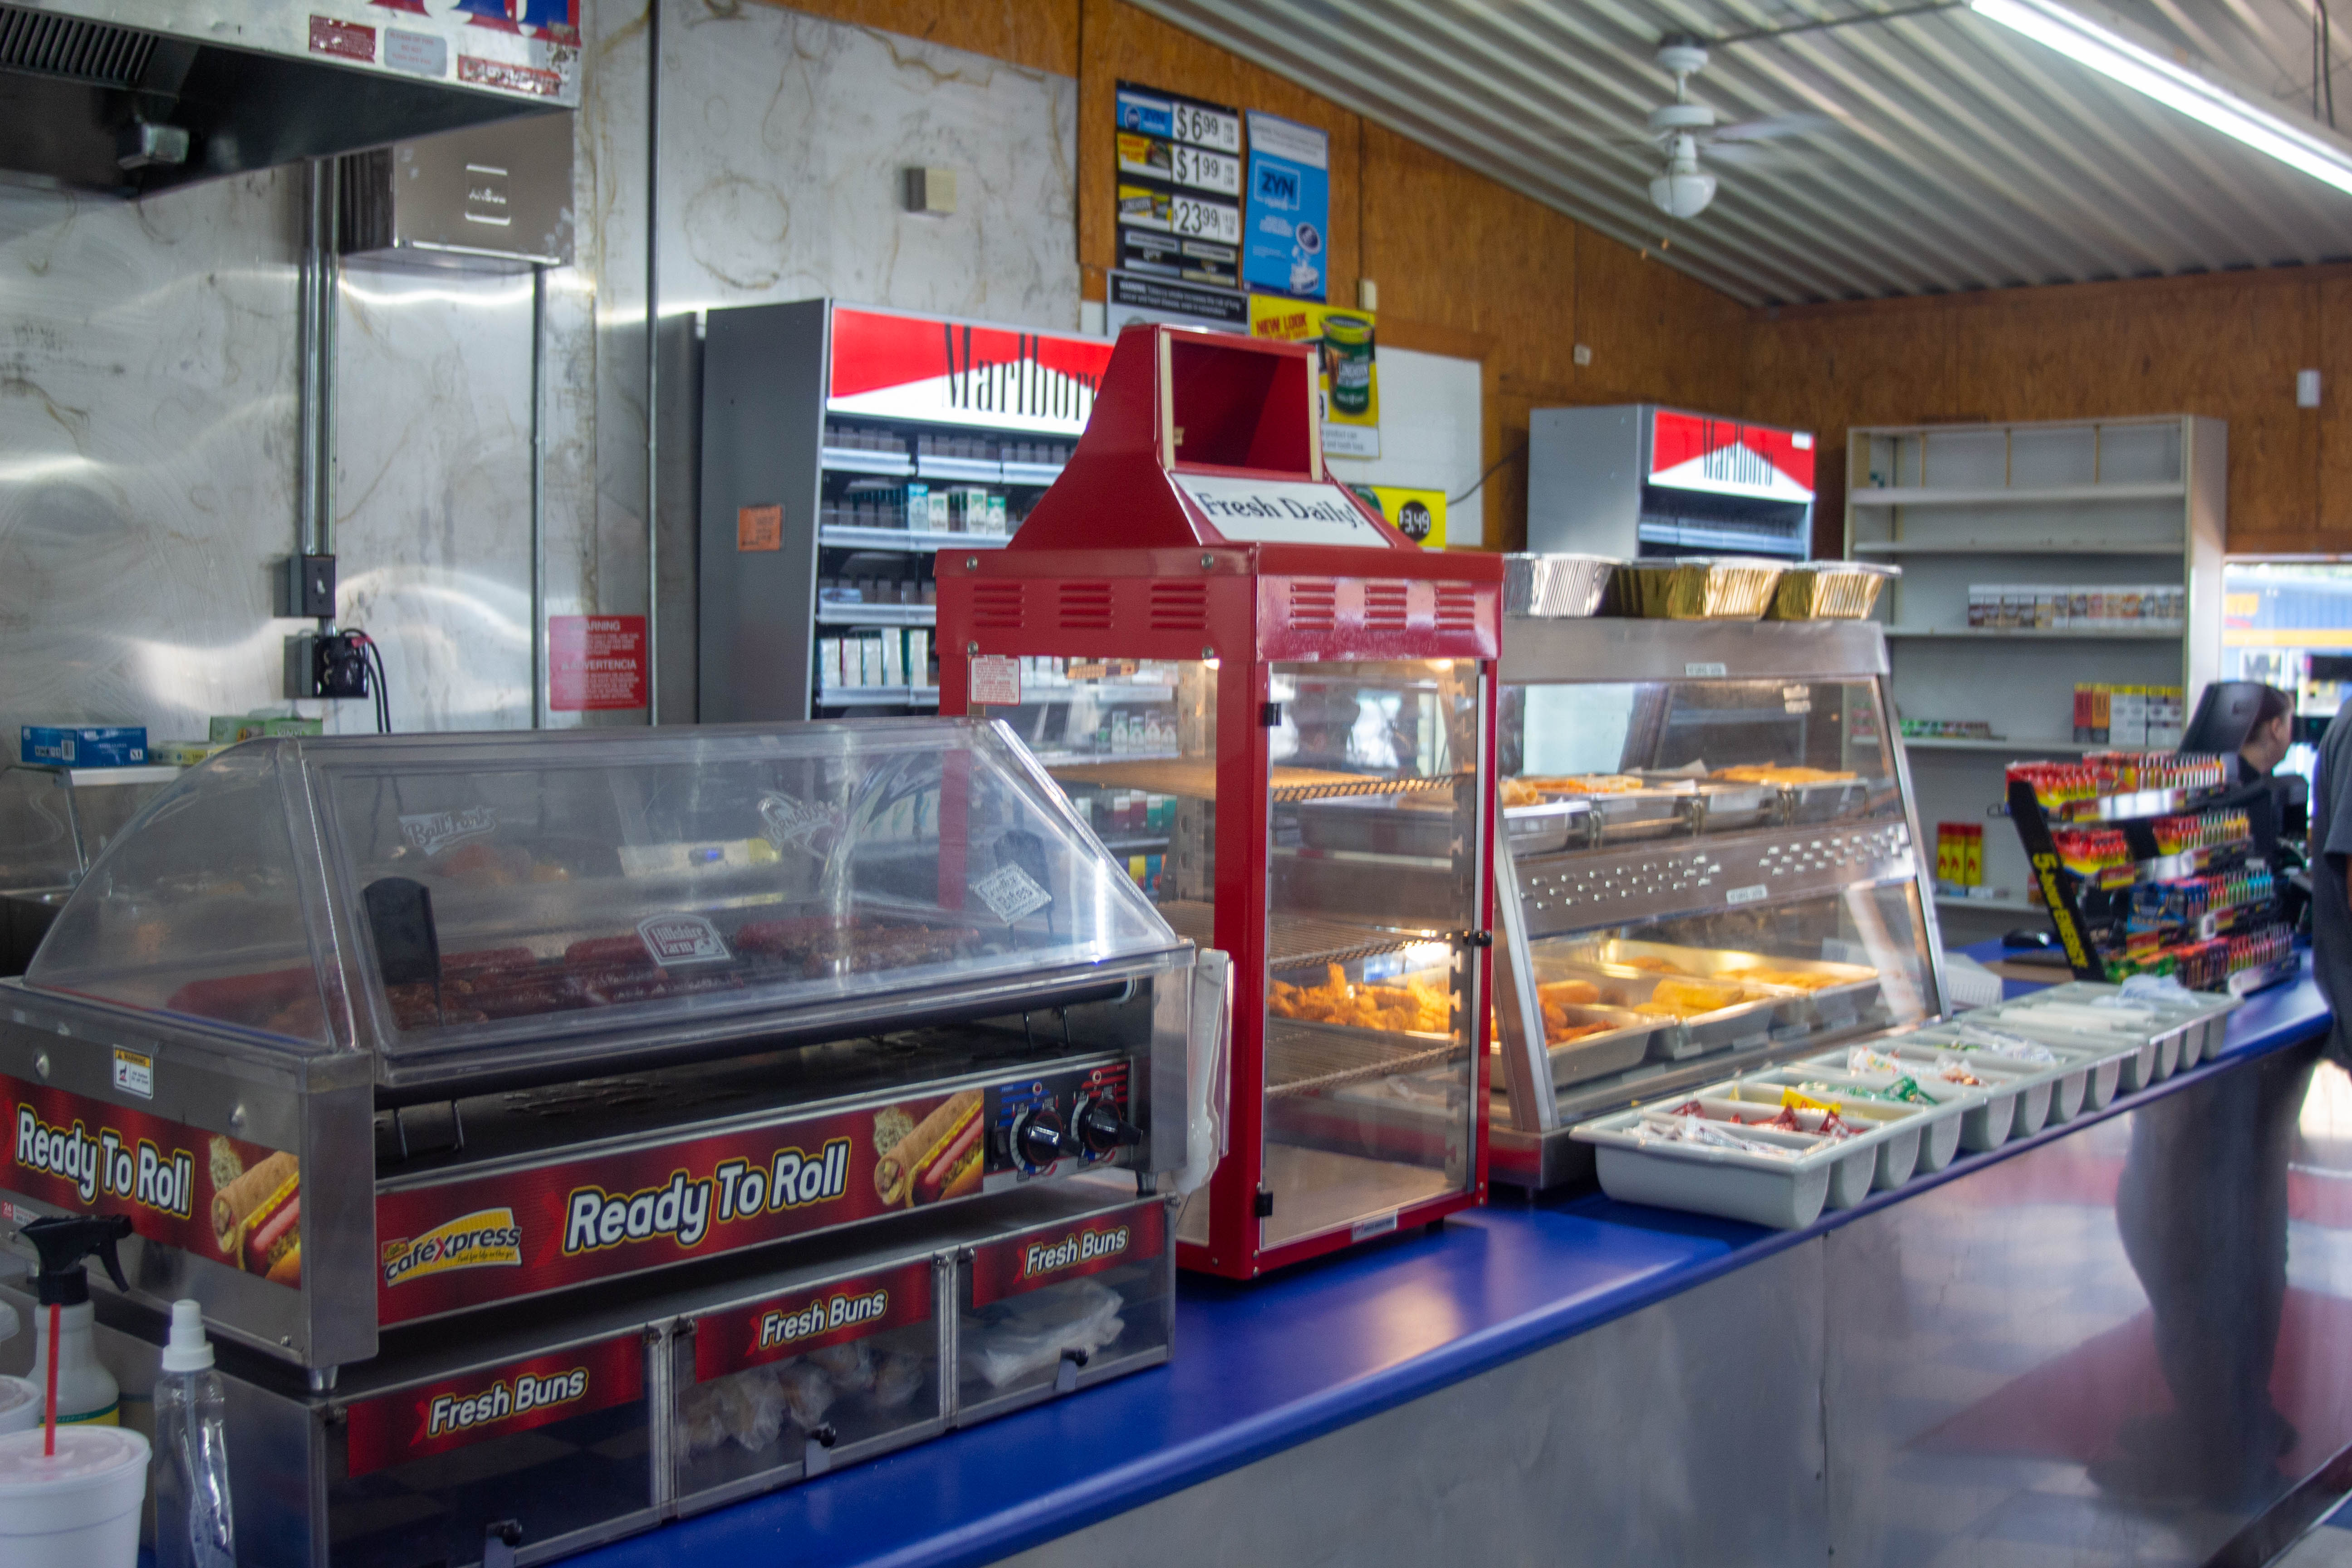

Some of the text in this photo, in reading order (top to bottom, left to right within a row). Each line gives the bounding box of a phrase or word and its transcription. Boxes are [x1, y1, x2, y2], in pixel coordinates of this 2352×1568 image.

[1262, 171, 1294, 198] ZYN
[1256, 318, 1280, 335] NEW
[1283, 312, 1307, 330] LOOK
[1701, 418, 1773, 486] Marlboro
[1196, 493, 1363, 529] Fresh Daily!
[404, 814, 446, 846] Ball
[651, 925, 703, 941] Hillshire
[659, 941, 694, 955] Farm
[18, 1108, 191, 1214] Ready To Roll
[4, 1202, 12, 1212] 24
[567, 1144, 847, 1252] Ready To Roll
[1026, 1229, 1127, 1274] Fresh Buns
[761, 1294, 885, 1346] Fresh Buns
[430, 1370, 585, 1435] Fresh Buns
